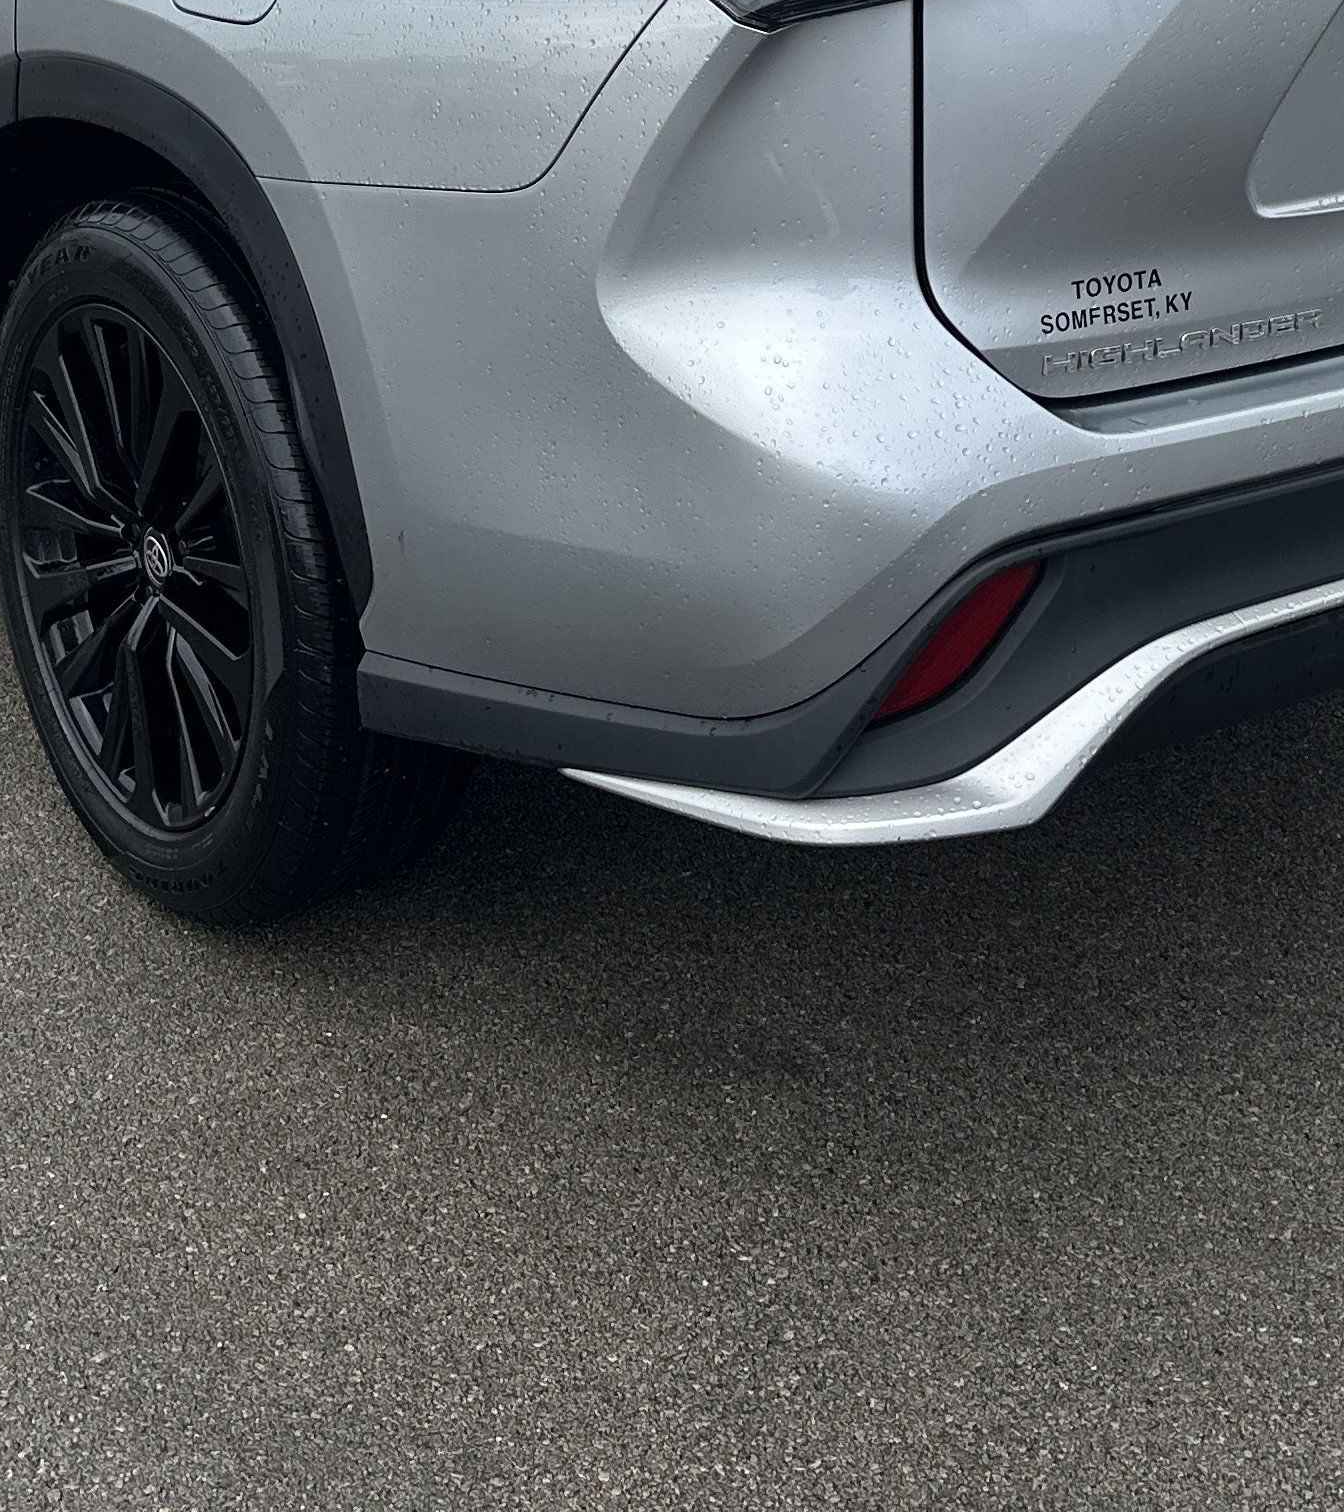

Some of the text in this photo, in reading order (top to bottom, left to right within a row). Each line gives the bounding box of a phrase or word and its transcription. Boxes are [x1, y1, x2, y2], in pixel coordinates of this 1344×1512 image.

[1070, 268, 1163, 300] TOYOTA
[1165, 291, 1194, 315] KY
[1041, 308, 1324, 377] HIGHLANDER
